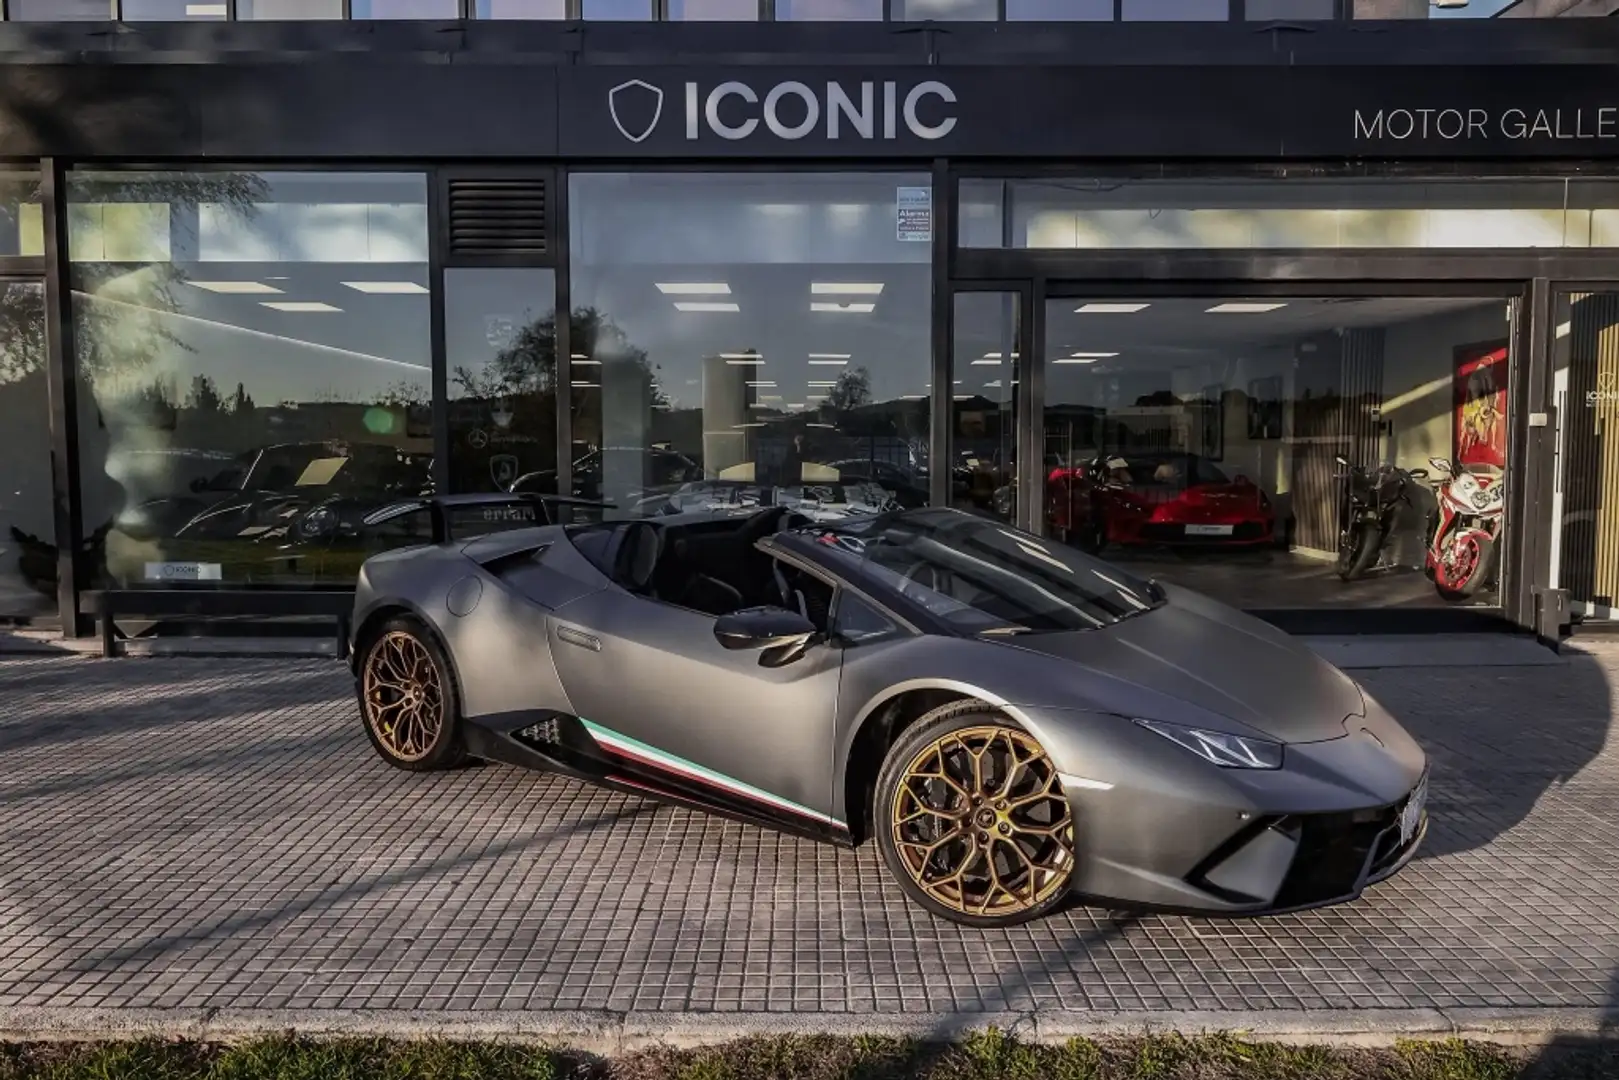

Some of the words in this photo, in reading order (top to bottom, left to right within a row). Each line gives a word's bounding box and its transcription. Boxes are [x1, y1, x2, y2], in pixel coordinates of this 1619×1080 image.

[685, 80, 958, 140] ICONIC
[1354, 108, 1488, 139] MOTOR
[1500, 107, 1618, 139] GALLE
